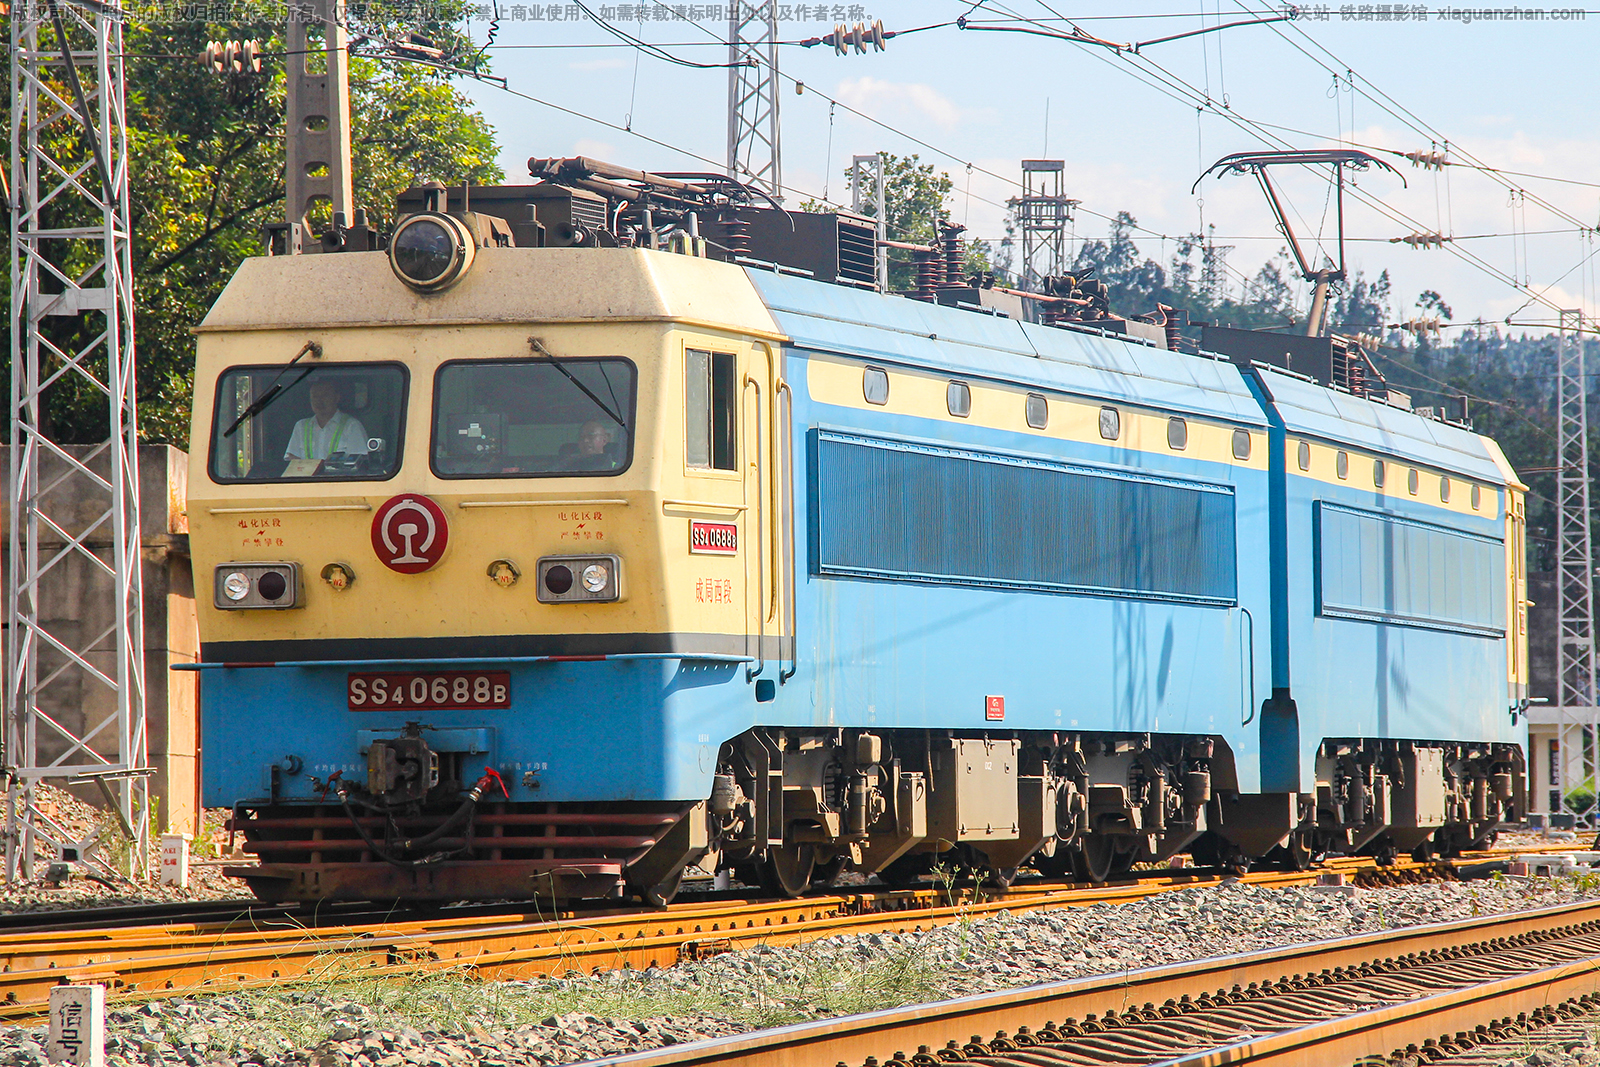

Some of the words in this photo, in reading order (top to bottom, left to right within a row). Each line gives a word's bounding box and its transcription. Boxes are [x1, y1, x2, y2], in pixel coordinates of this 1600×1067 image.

[558, 511, 602, 521] 电化区段
[238, 518, 281, 528] 电化区段
[56, 1001, 83, 1056] 信号
